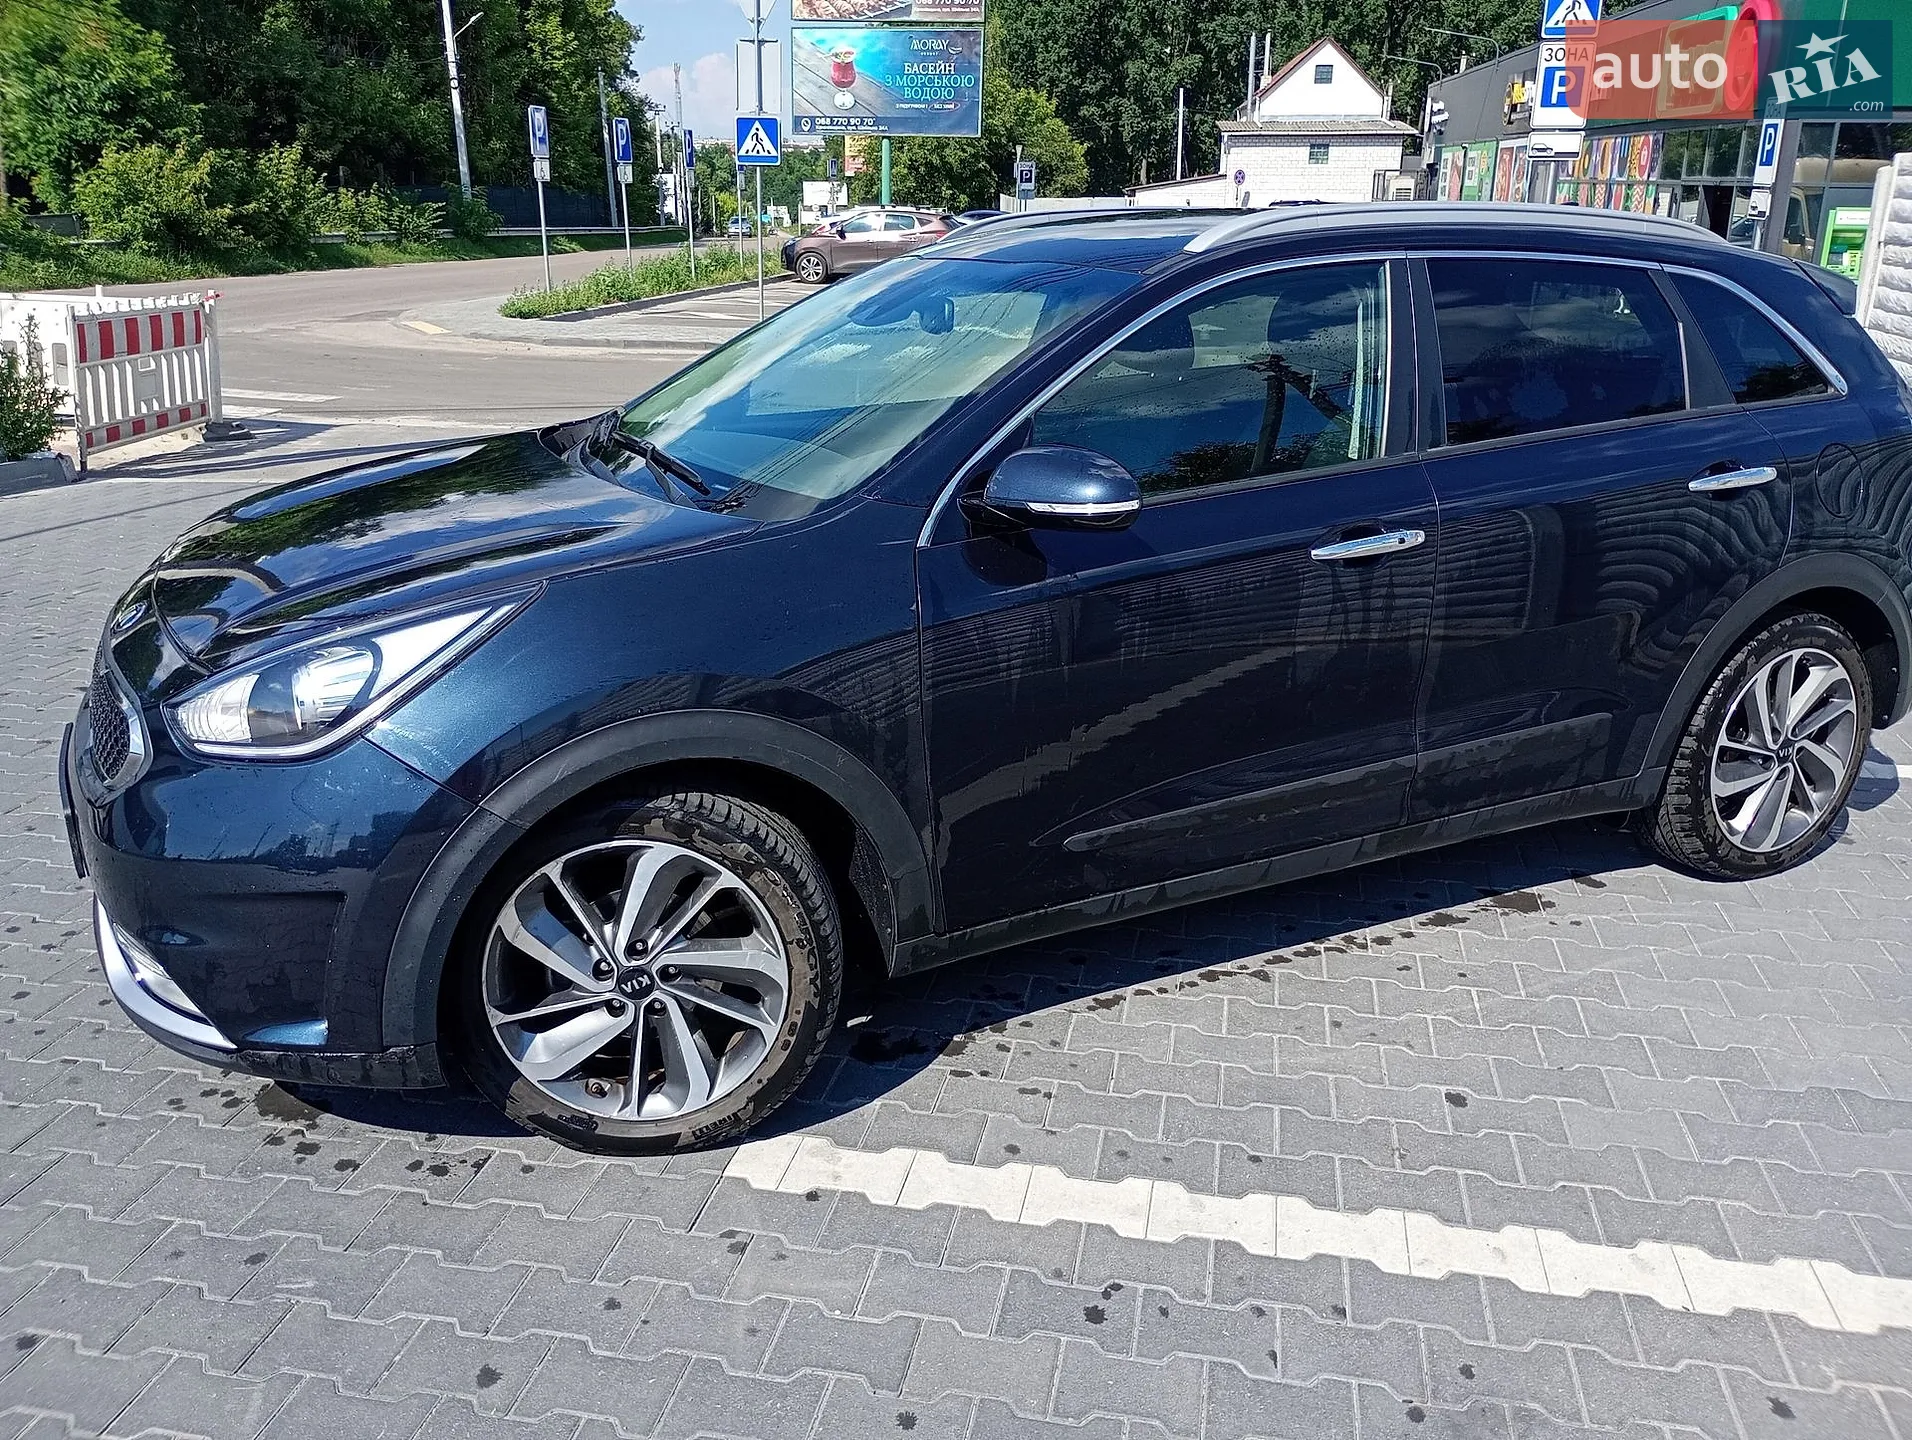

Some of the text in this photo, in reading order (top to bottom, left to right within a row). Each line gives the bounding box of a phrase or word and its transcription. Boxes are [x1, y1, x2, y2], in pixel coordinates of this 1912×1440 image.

[910, 39, 949, 50] MORAY
[1544, 46, 1589, 63] ЗОНА
[903, 61, 955, 75] БАСЕЙН
[884, 75, 975, 87] З МОРСЬКОЮ
[1551, 69, 1577, 104] P
[904, 87, 955, 101] ВОДОЮ
[832, 117, 848, 125] 770
[620, 974, 652, 993] KIA
